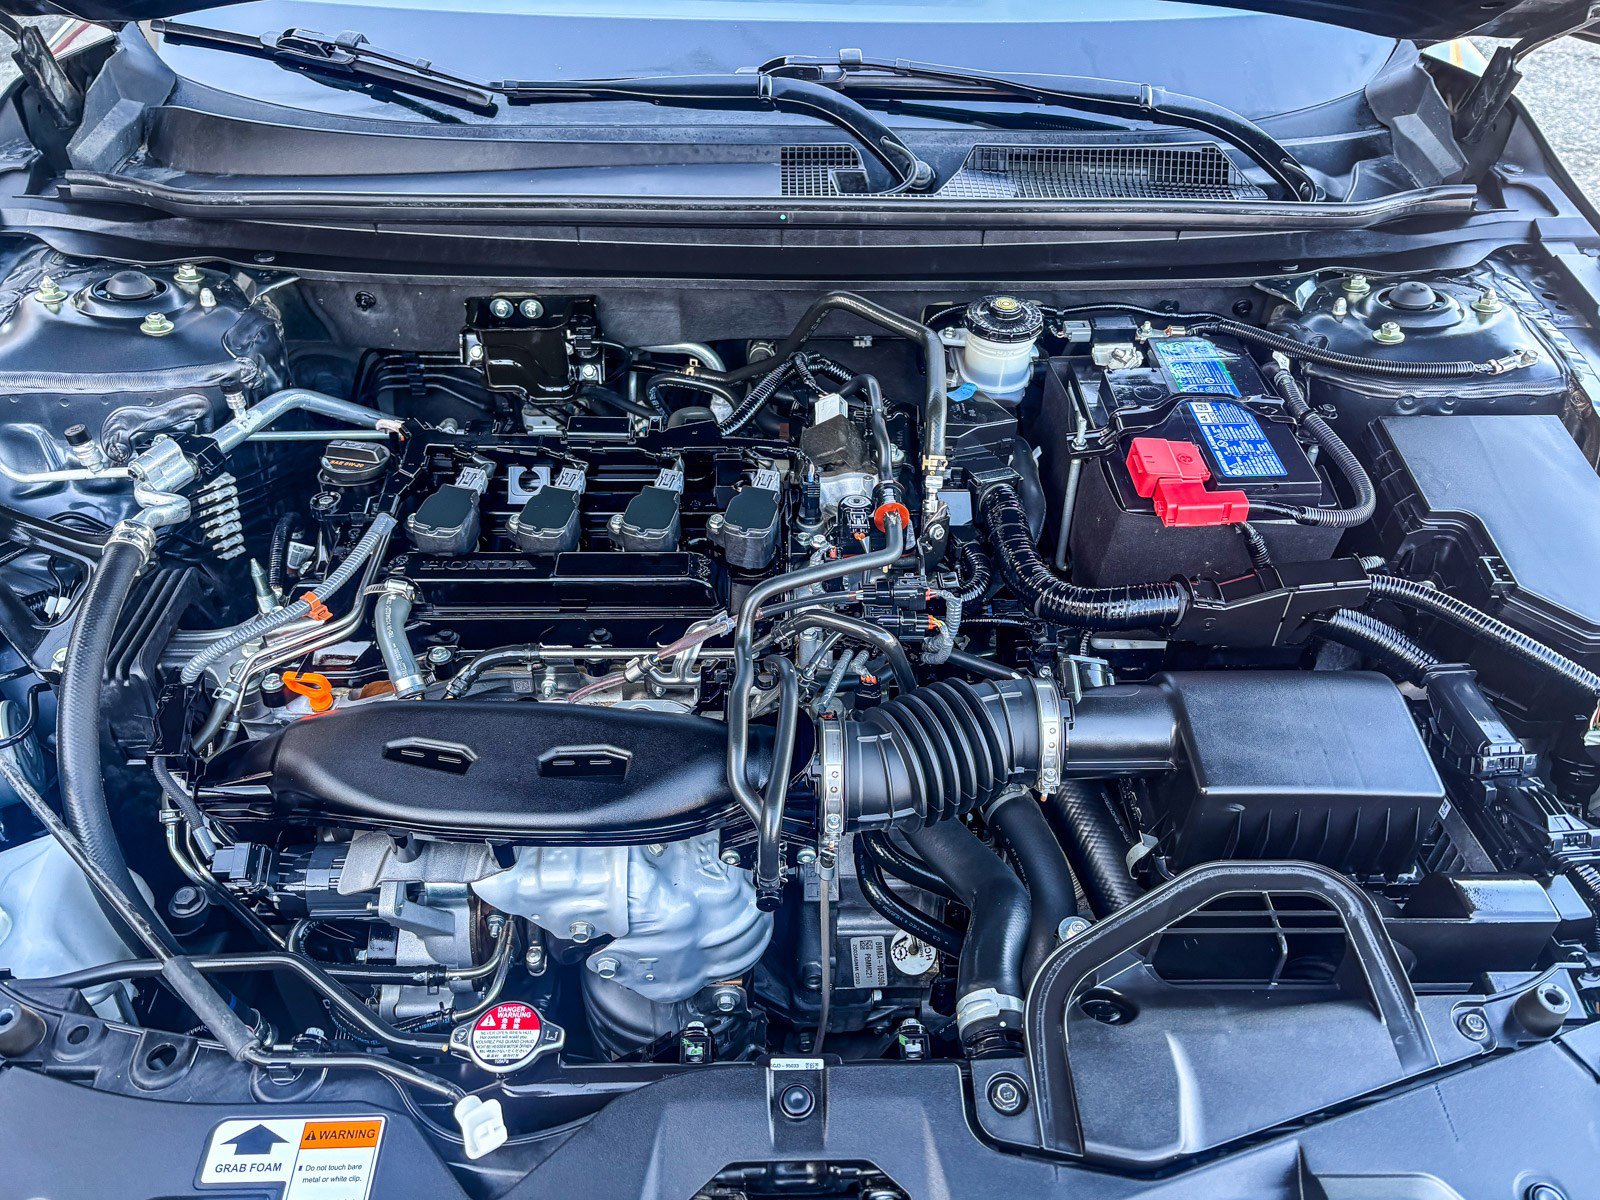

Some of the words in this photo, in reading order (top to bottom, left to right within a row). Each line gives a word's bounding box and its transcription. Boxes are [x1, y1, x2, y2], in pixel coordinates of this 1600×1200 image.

[420, 560, 536, 570] HONDA
[319, 1129, 375, 1139] WARNING
[215, 1164, 246, 1173] GRAB
[250, 1162, 282, 1172] FOAM
[349, 1175, 362, 1183] clip.
